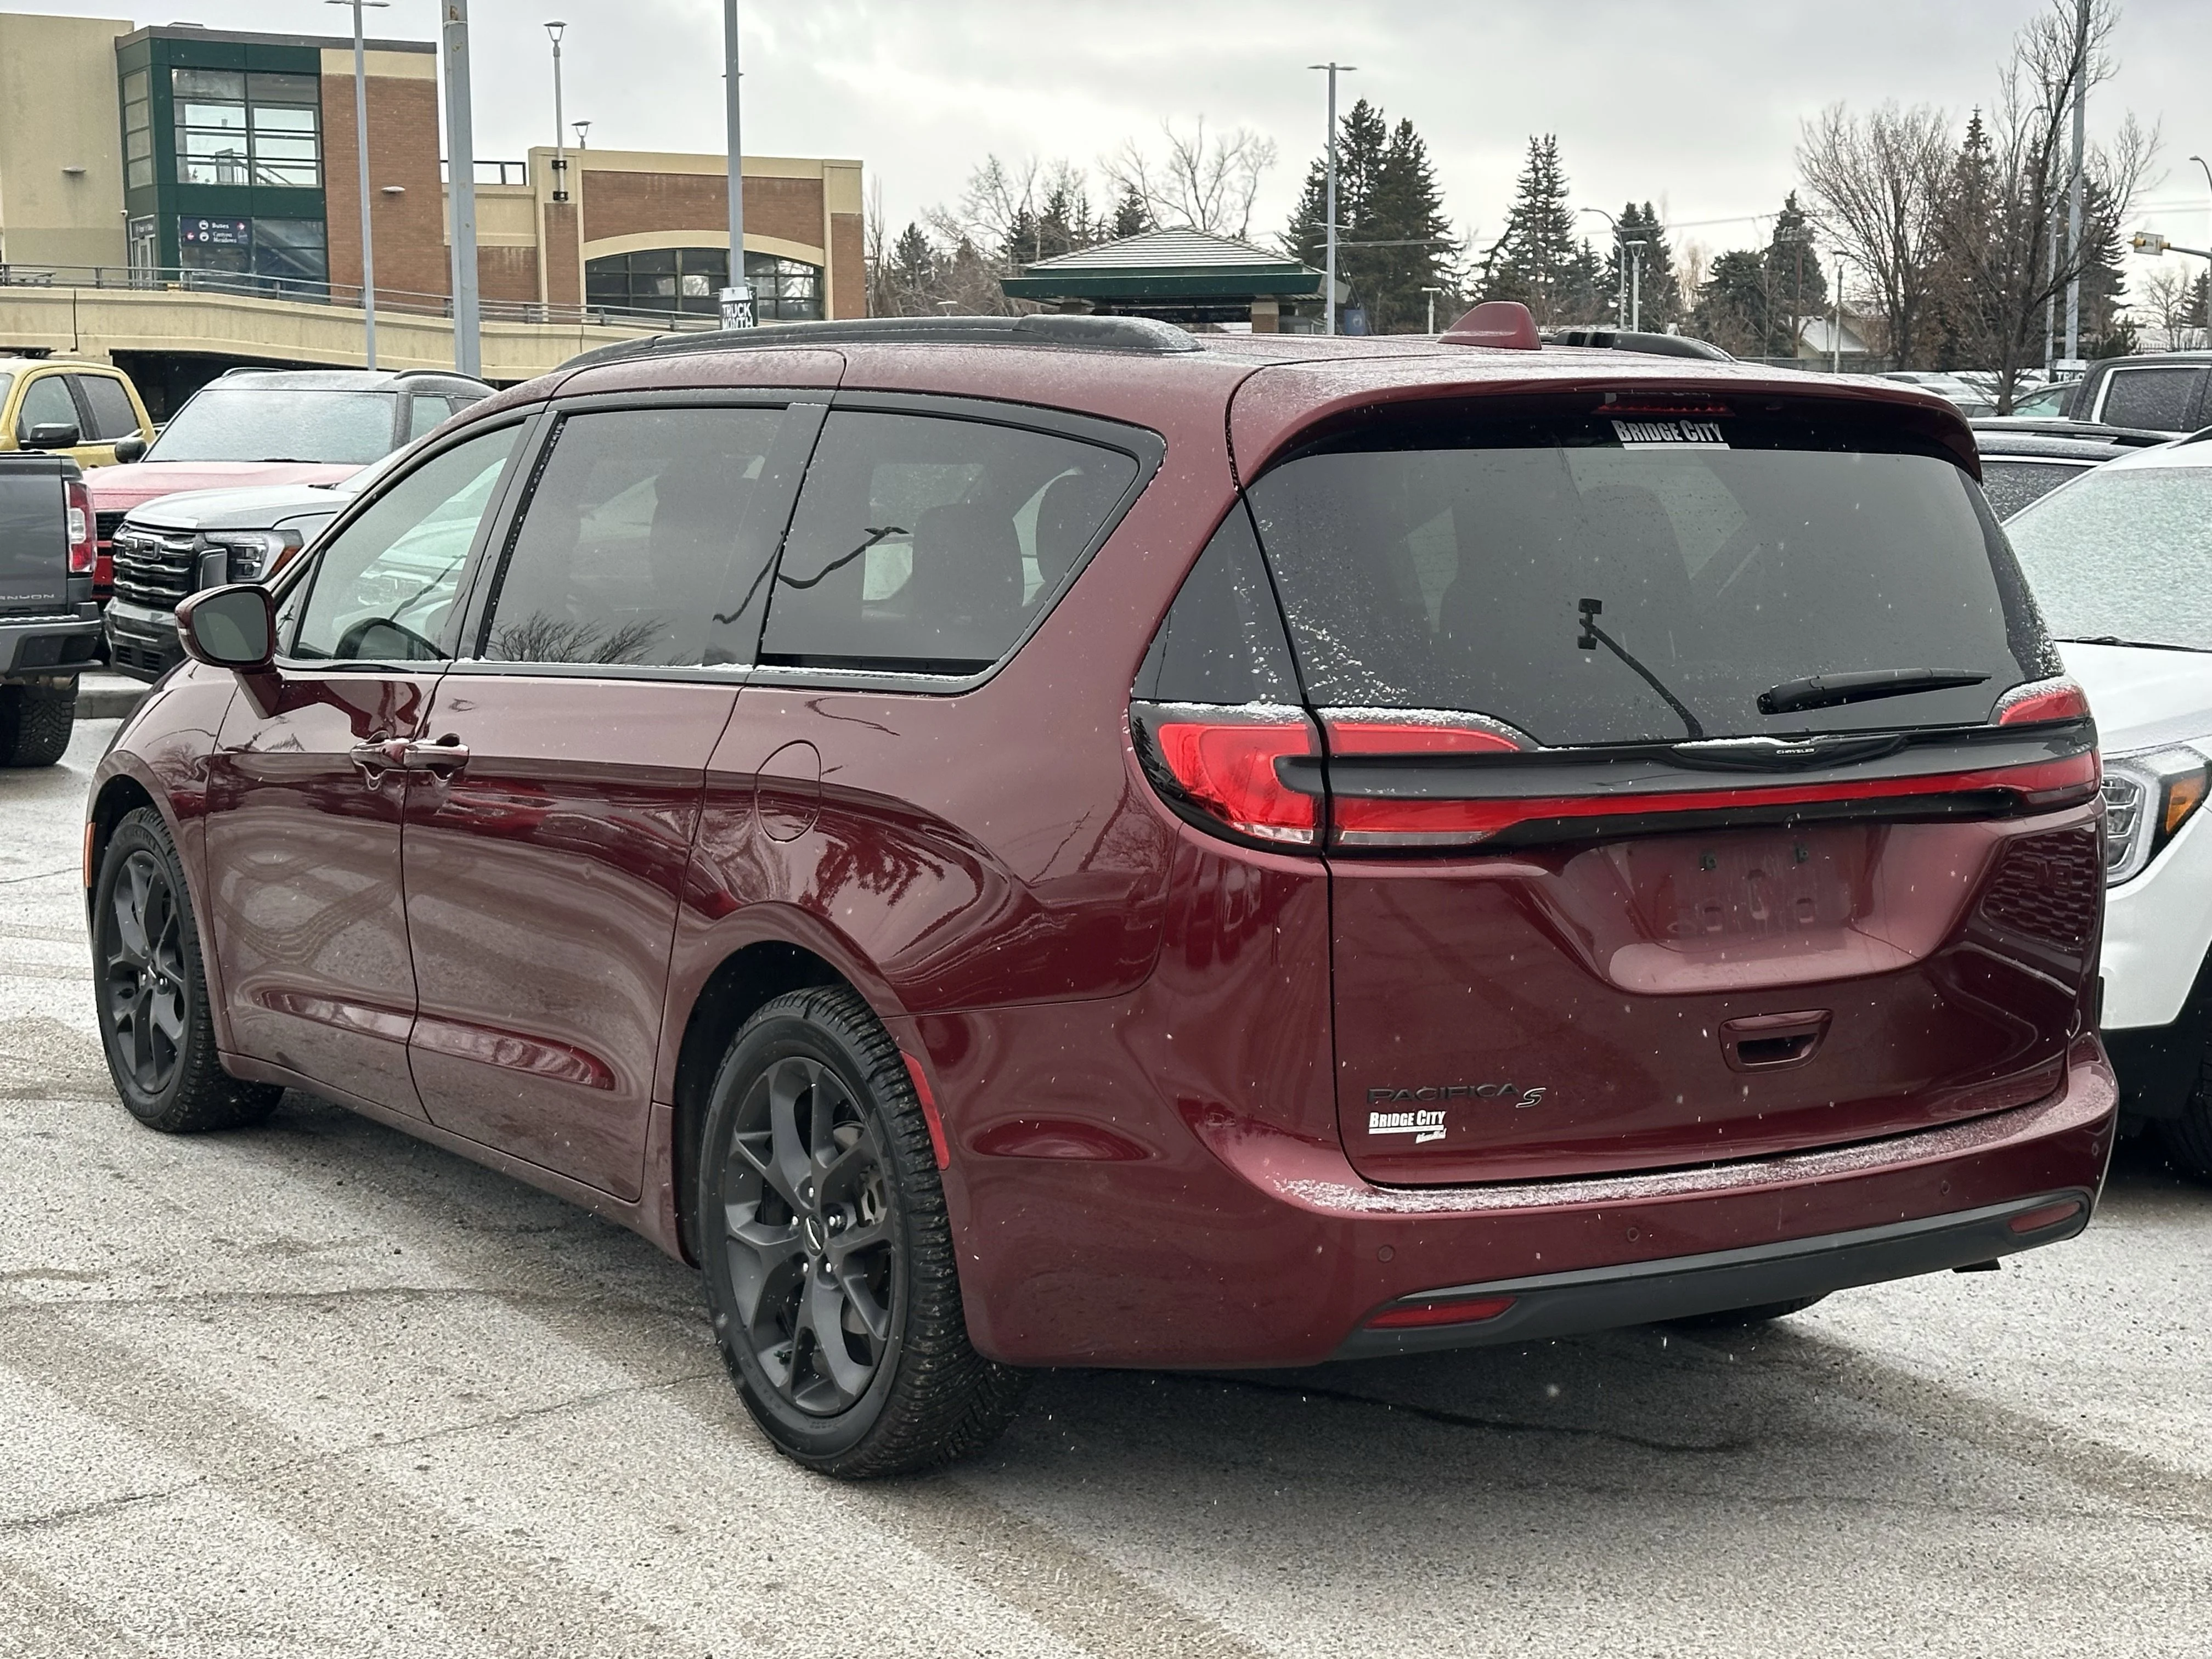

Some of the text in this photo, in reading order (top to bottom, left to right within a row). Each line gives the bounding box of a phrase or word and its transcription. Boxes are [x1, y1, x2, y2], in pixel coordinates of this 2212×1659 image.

[722, 302, 752, 318] TRUCK
[722, 317, 753, 329] MONTH
[1611, 420, 1724, 442] BRIDGE CITY
[1367, 1083, 1547, 1108] PACIFICA S
[1369, 1109, 1447, 1128] BRIDGE CITY
